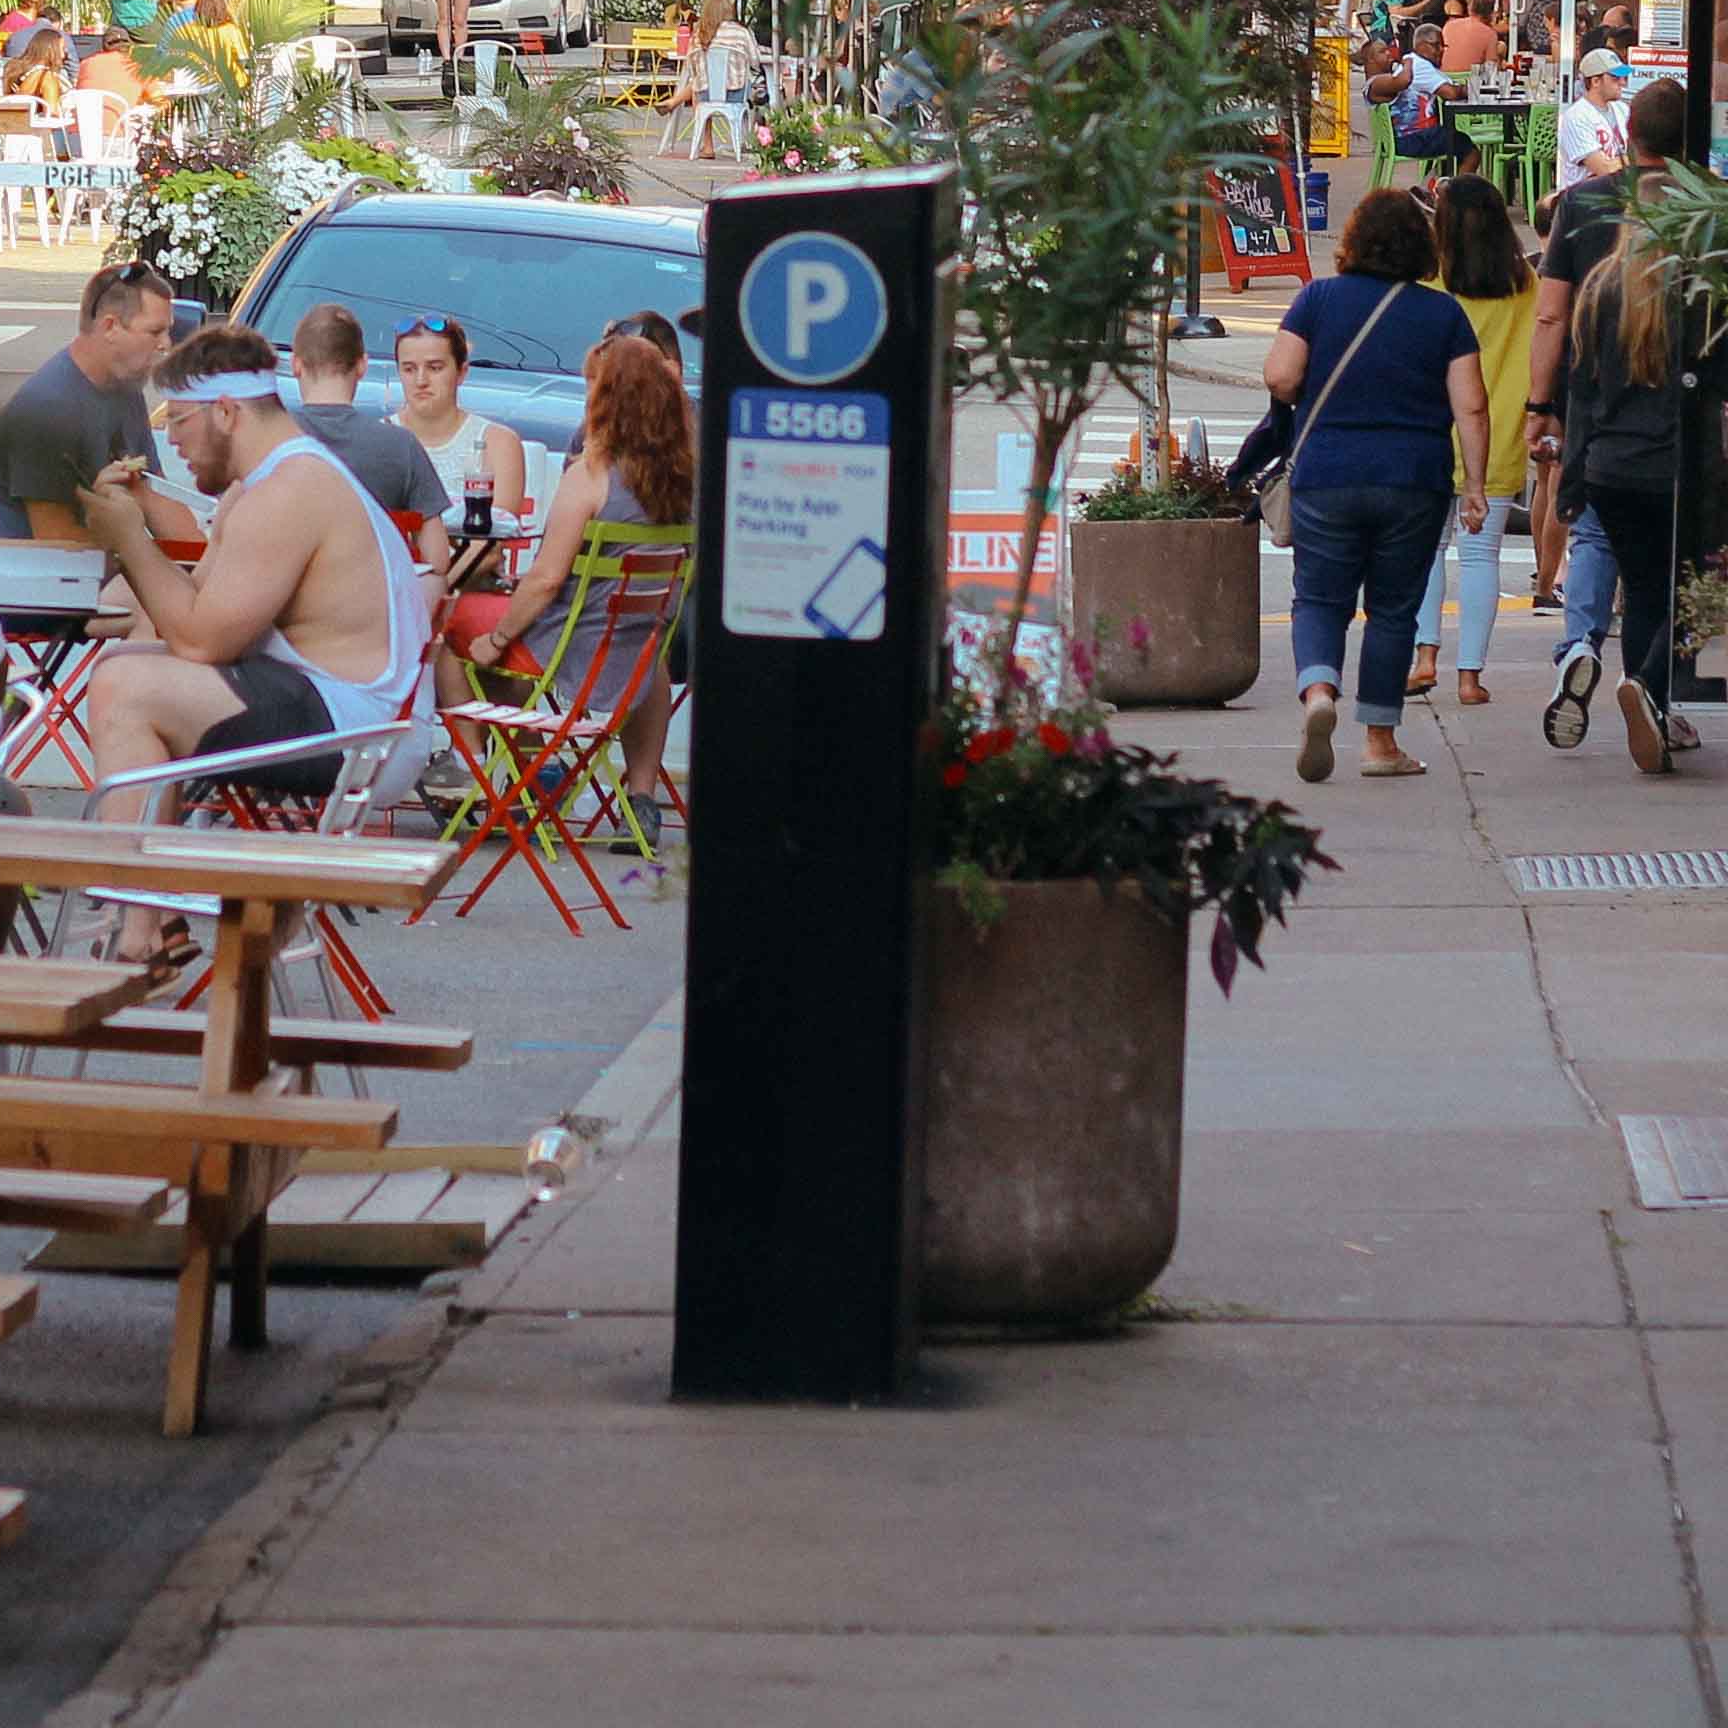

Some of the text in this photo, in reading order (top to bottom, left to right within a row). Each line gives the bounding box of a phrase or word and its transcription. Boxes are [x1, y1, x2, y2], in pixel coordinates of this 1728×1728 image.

[1632, 67, 1656, 79] LINE
[45, 165, 92, 186] PGH
[1244, 196, 1274, 218] HOUR
[1250, 230, 1271, 245] 4-7
[786, 260, 850, 360] P
[766, 401, 867, 440] 5566
[948, 535, 1054, 568] LINE
